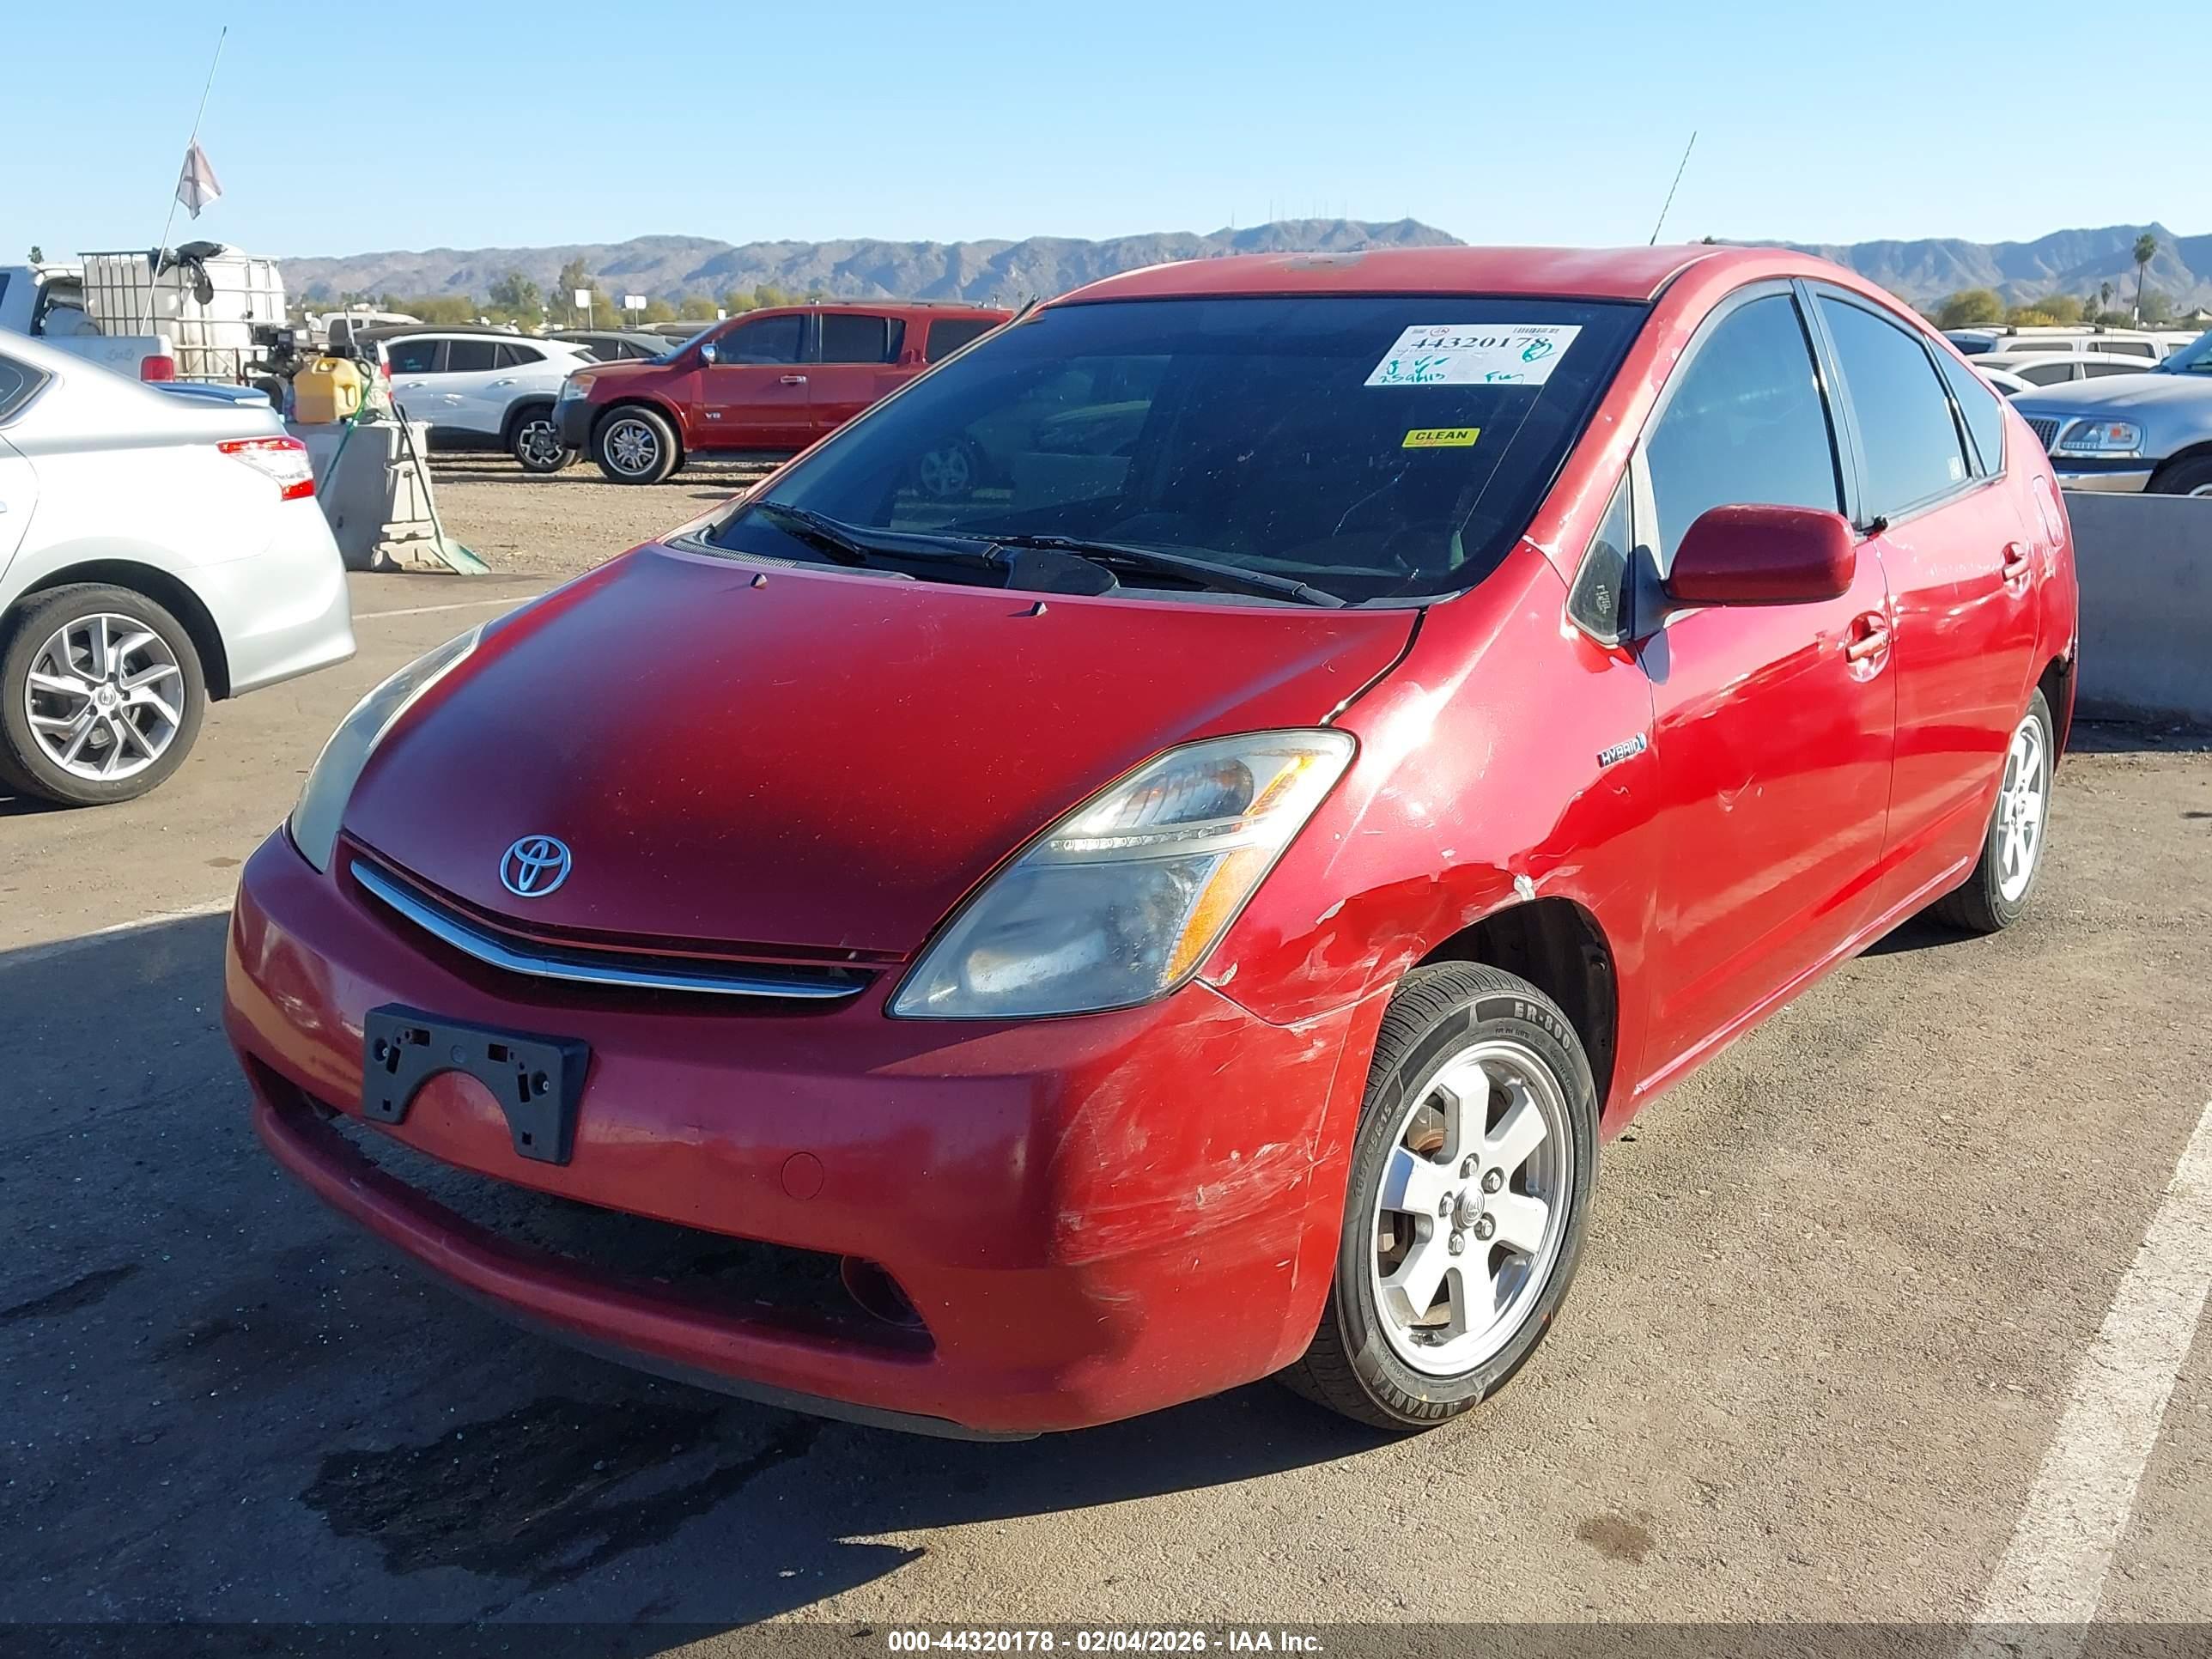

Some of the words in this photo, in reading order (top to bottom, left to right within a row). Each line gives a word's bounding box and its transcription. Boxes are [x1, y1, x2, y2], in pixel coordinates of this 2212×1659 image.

[1411, 337, 1550, 349] 44320178
[1414, 430, 1468, 440] CLEAN
[1601, 734, 1646, 766] HYBRID
[1371, 1367, 1462, 1419] ADVANTA
